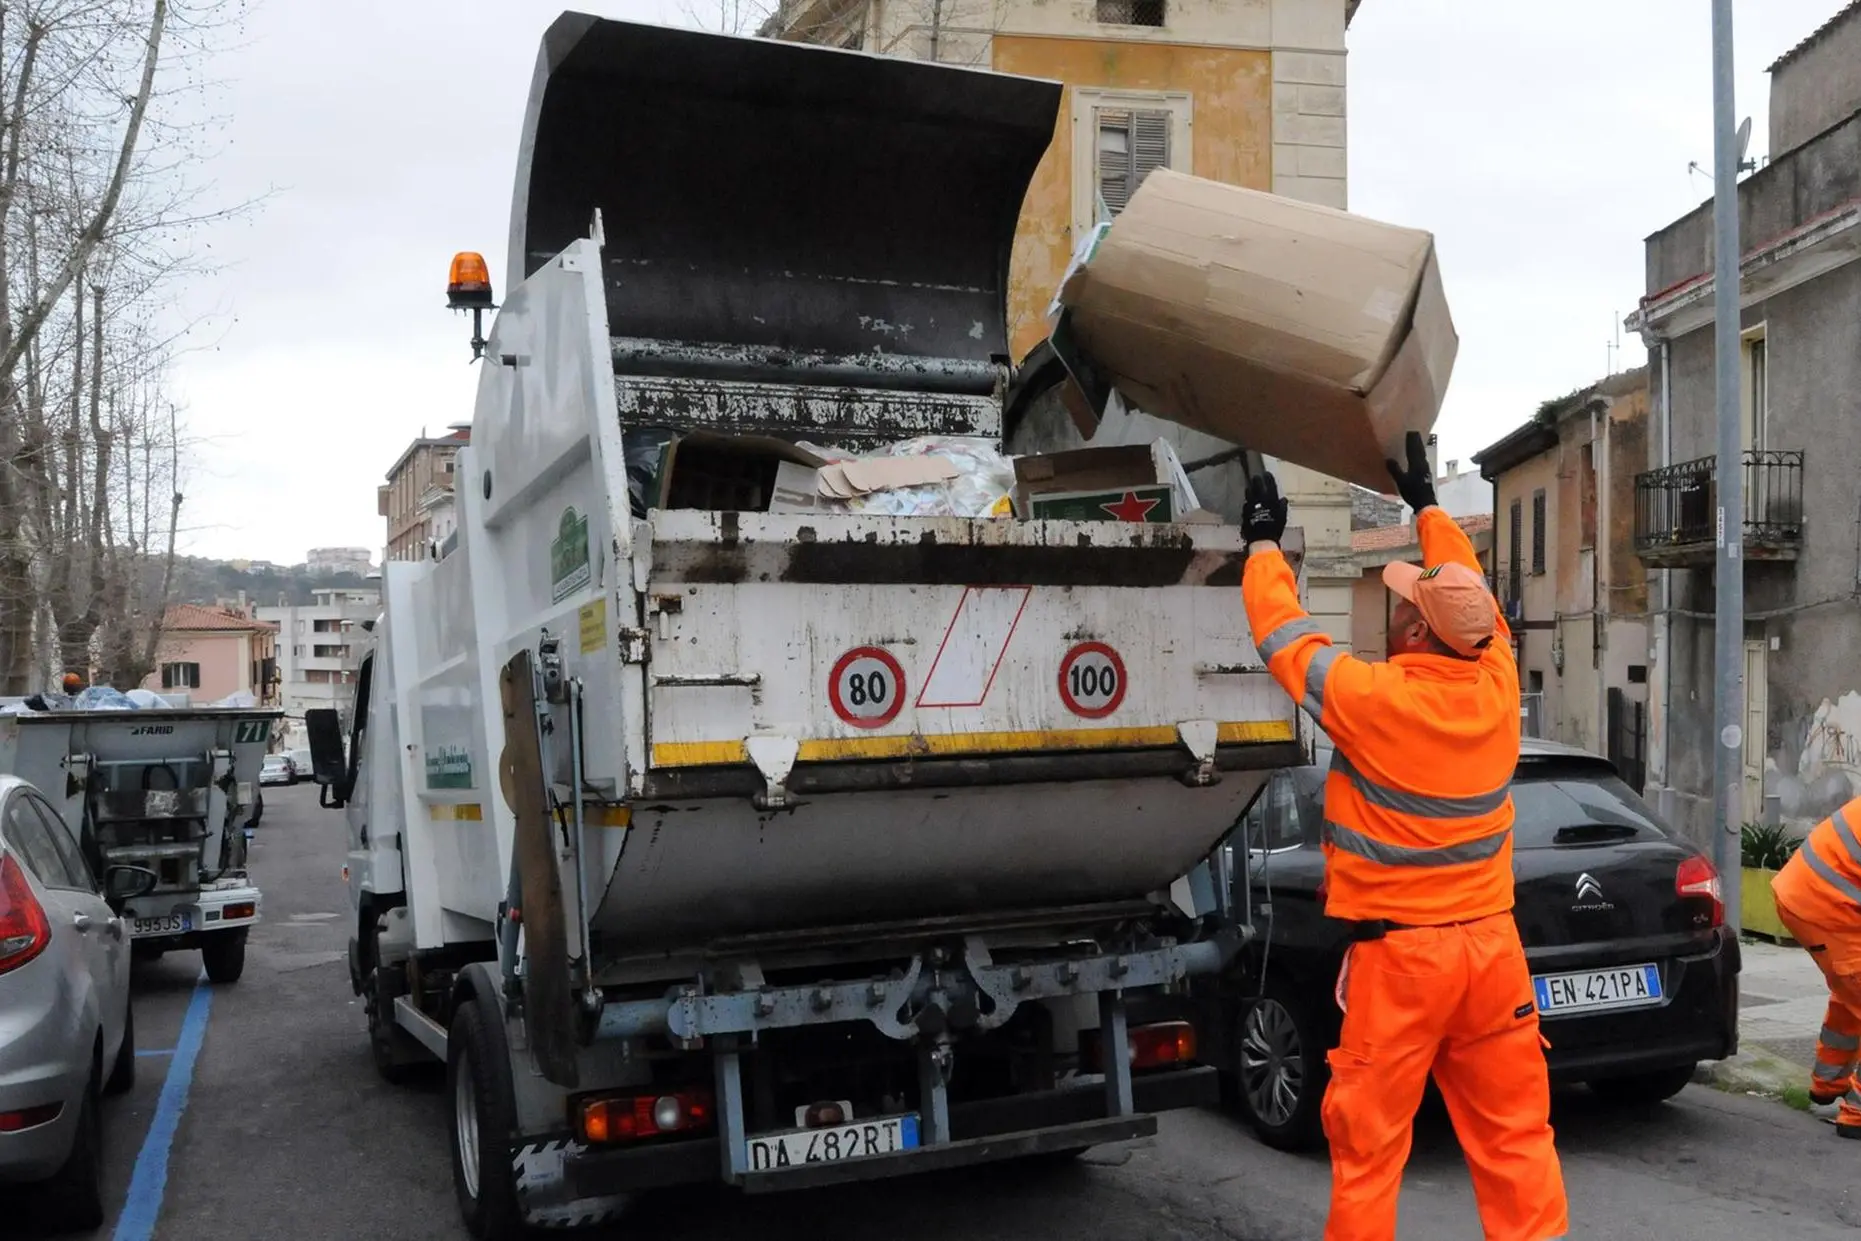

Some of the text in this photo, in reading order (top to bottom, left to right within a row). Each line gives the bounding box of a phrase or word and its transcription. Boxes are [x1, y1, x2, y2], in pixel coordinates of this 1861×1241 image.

[849, 670, 886, 706] 80
[1070, 664, 1116, 697] 100
[140, 725, 174, 735] FARID
[243, 721, 263, 742] 71
[1550, 970, 1647, 1006] EN 421PA
[752, 1121, 898, 1170] DA 482RT
